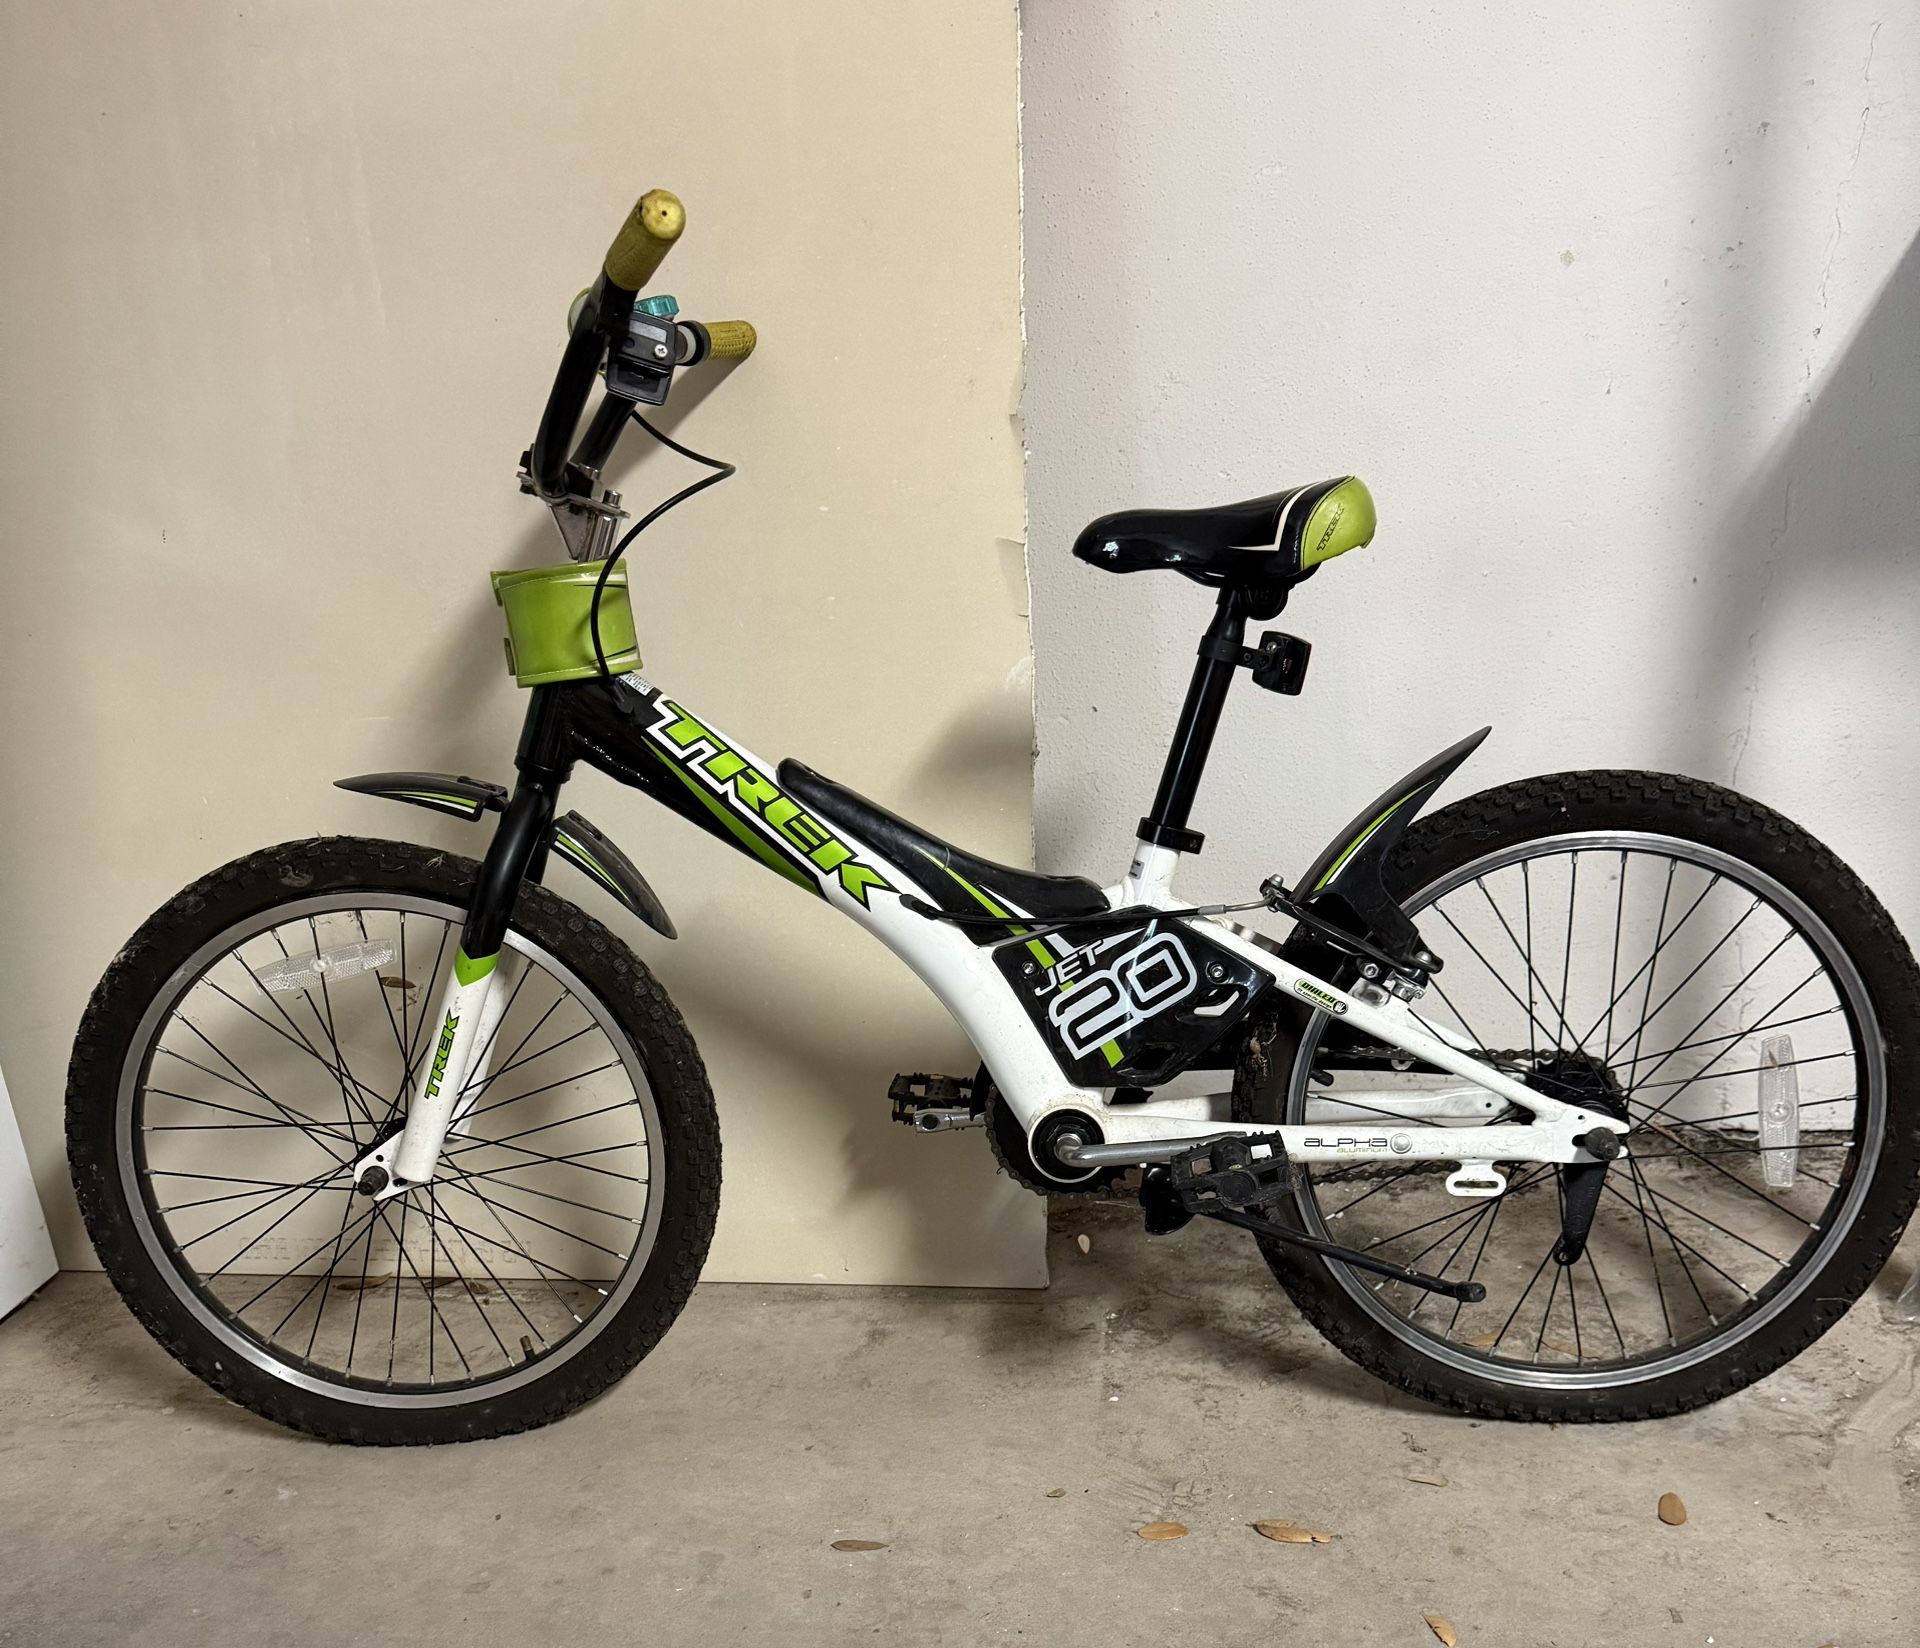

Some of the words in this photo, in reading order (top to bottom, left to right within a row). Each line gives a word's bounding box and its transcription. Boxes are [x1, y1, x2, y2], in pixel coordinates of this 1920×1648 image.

[1316, 503, 1344, 550] TREK
[657, 700, 900, 912] TREK
[1034, 939, 1105, 996] JET
[1048, 932, 1198, 1061] 20
[1301, 982, 1337, 1003] DIALED
[424, 1008, 460, 1099] TREK
